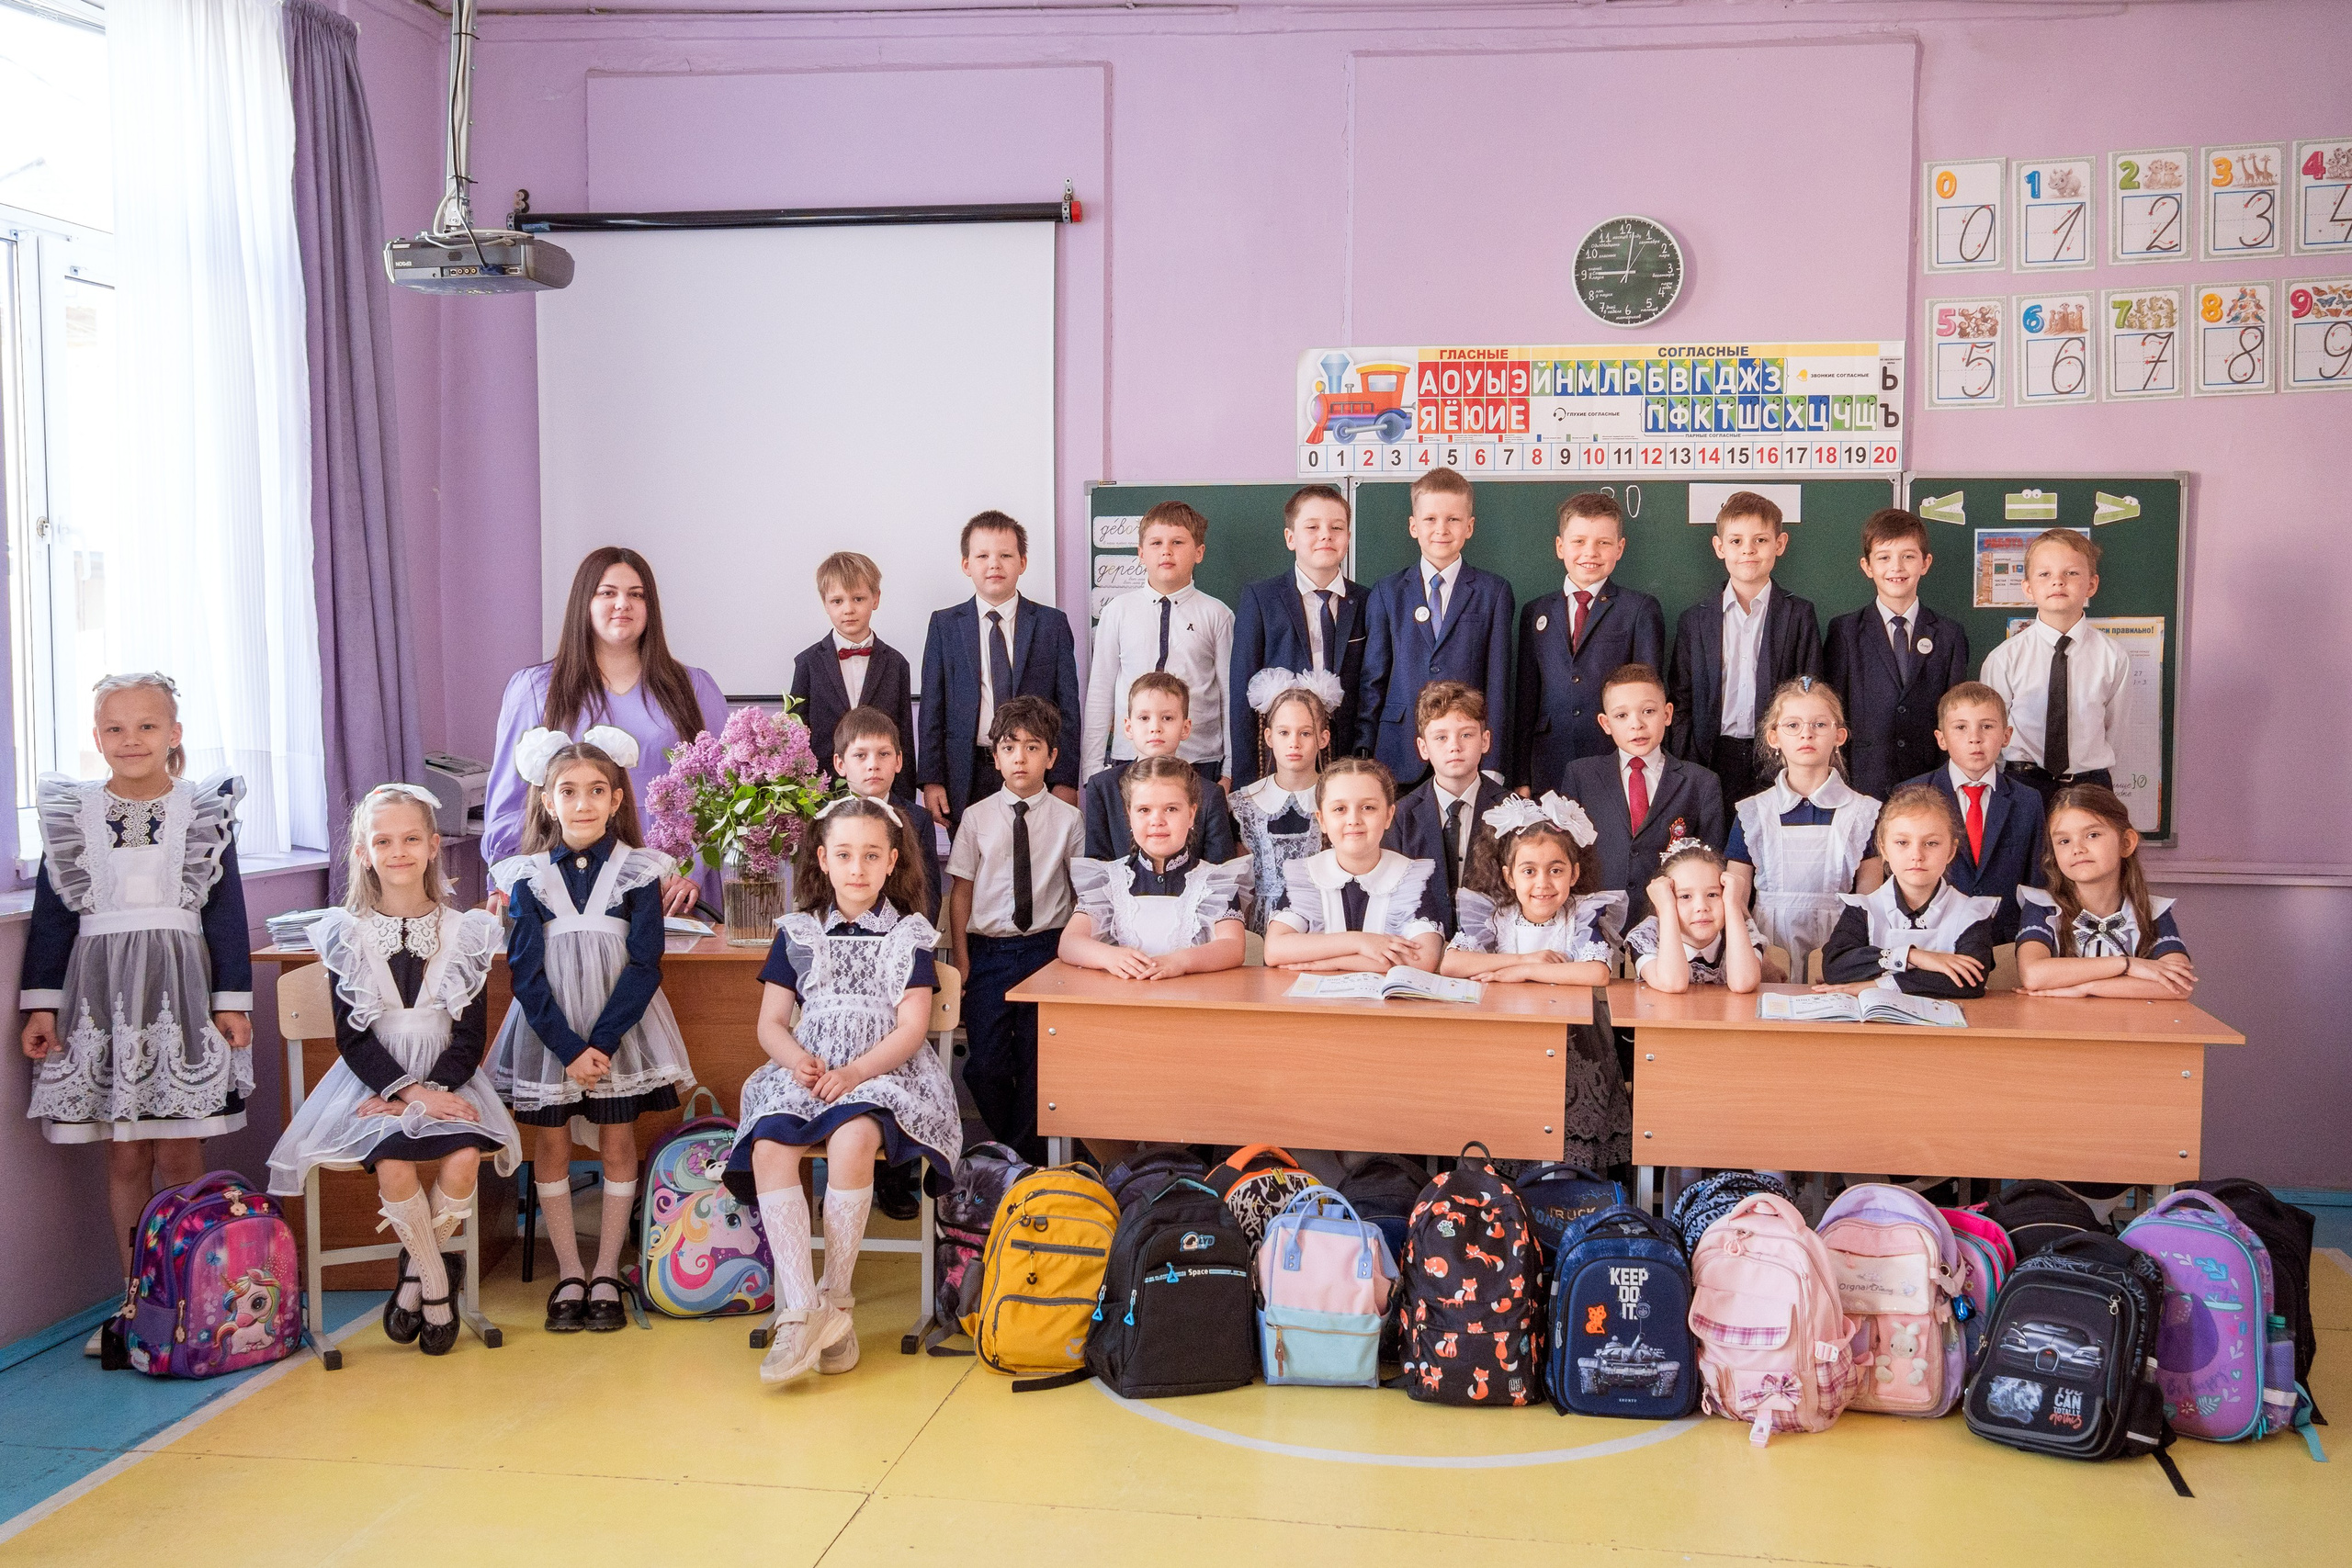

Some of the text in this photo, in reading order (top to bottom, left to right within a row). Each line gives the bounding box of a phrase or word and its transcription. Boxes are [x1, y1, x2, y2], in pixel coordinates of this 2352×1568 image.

[2119, 161, 2141, 190] 2
[2211, 157, 2233, 187] 3
[2302, 151, 2326, 180] 4
[1936, 171, 1957, 198] 0
[2024, 171, 2041, 199] 1
[1620, 223, 1632, 235] 12
[2146, 196, 2180, 253] 2
[2239, 190, 2274, 247] 3
[1600, 232, 1611, 243] 11
[1645, 230, 1652, 240] 1
[1960, 205, 1994, 263] 0
[2052, 203, 2085, 261] 1
[1586, 248, 1599, 259] 10
[1661, 243, 1668, 254] 2
[1581, 270, 1588, 280] 9
[1668, 263, 1673, 274] 3
[1589, 290, 1595, 300] 8
[1645, 298, 1653, 308] 5
[1657, 287, 1665, 298] 4
[1599, 302, 1605, 313] 7
[1624, 305, 1631, 315] 6
[2201, 293, 2223, 323] 8
[2290, 289, 2312, 319] 9
[1936, 308, 1956, 337] 5
[2023, 305, 2044, 334] 6
[2111, 300, 2132, 330] 7
[1440, 349, 1509, 360] ГЛАСНЫЕ
[1658, 346, 1749, 357] СОГЛАСНЫЕ
[2142, 332, 2174, 390] 7
[2228, 326, 2265, 384] 8
[1962, 343, 1995, 398] 5
[2052, 337, 2086, 395] 6
[1882, 366, 1899, 390] Ь
[1880, 403, 1899, 427] Ъ
[1308, 446, 1897, 467] 0 1 2 3 4 5 6 7 8 9 10 11 12 13 14 15 16 17 18 19 20
[2112, 626, 2154, 635] правильно!
[1188, 1269, 1209, 1277] Space
[1610, 1267, 1649, 1286] KEEP
[1619, 1285, 1640, 1303] DO
[2053, 1406, 2081, 1416] TOTALLY
[2054, 1393, 2082, 1410] CAN
